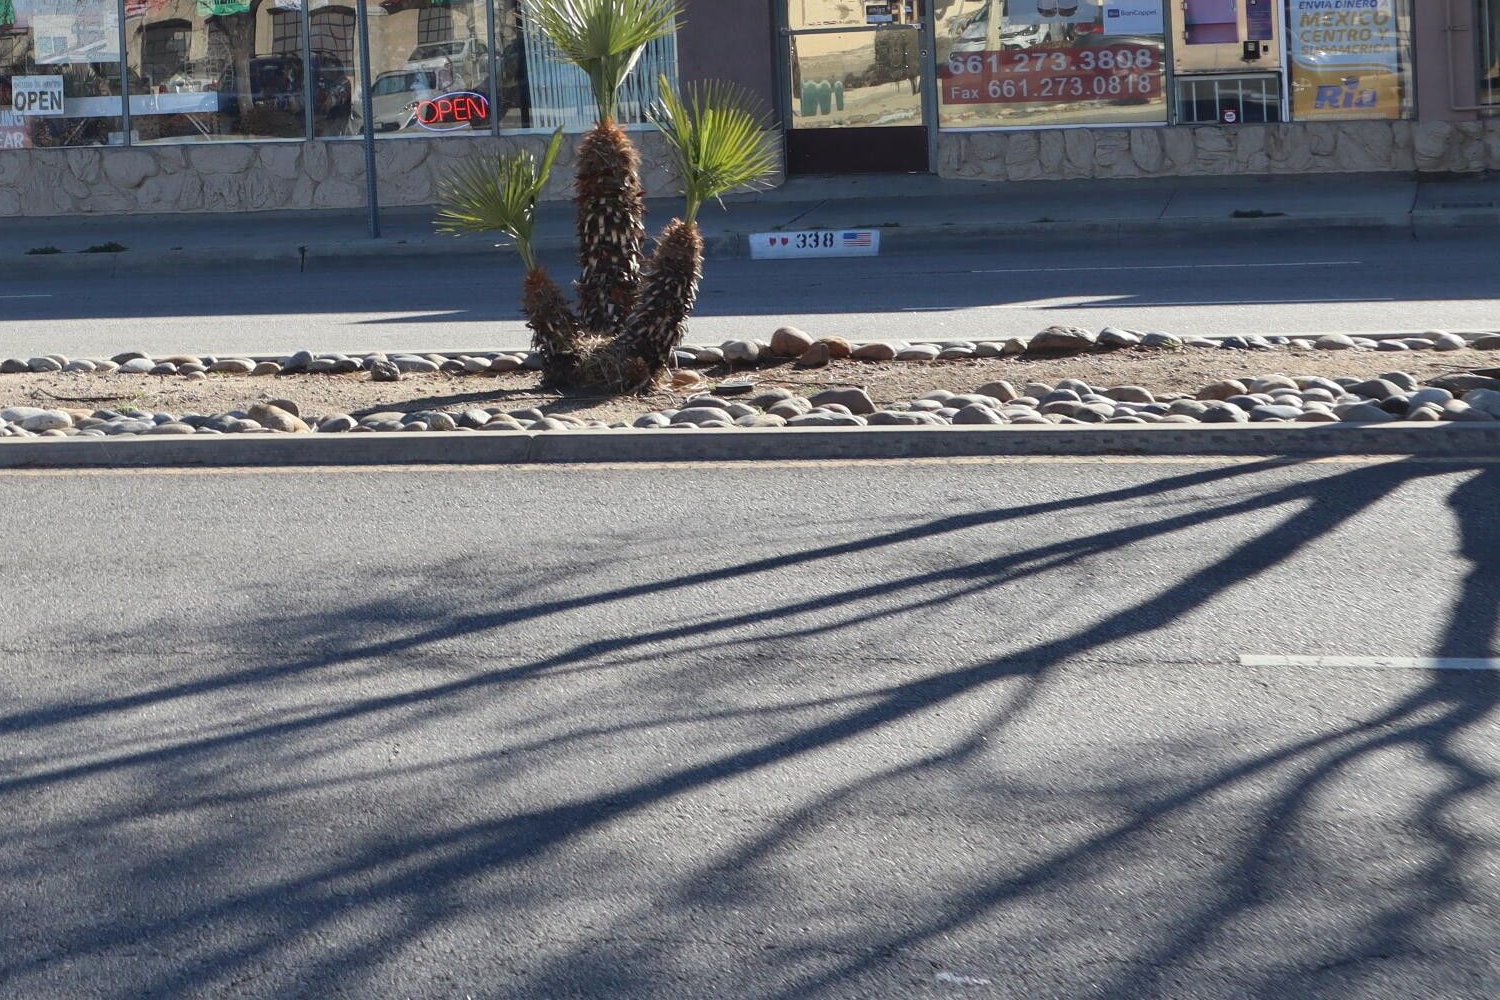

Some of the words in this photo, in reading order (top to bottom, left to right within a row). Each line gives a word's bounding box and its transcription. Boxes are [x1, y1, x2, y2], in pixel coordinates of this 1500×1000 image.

[1298, 0, 1332, 10] ENVIA
[1334, 0, 1378, 9] DINERO
[1300, 10, 1392, 27] MEXICO
[1300, 27, 1372, 43] CENTRO
[948, 48, 1153, 75] 661.273.3808
[951, 86, 980, 100] Fax
[988, 75, 1151, 99] 661.273.0818
[1314, 75, 1378, 110] Ria
[14, 90, 62, 112] OPEN
[417, 97, 486, 124] OPEN
[796, 232, 834, 249] 338
